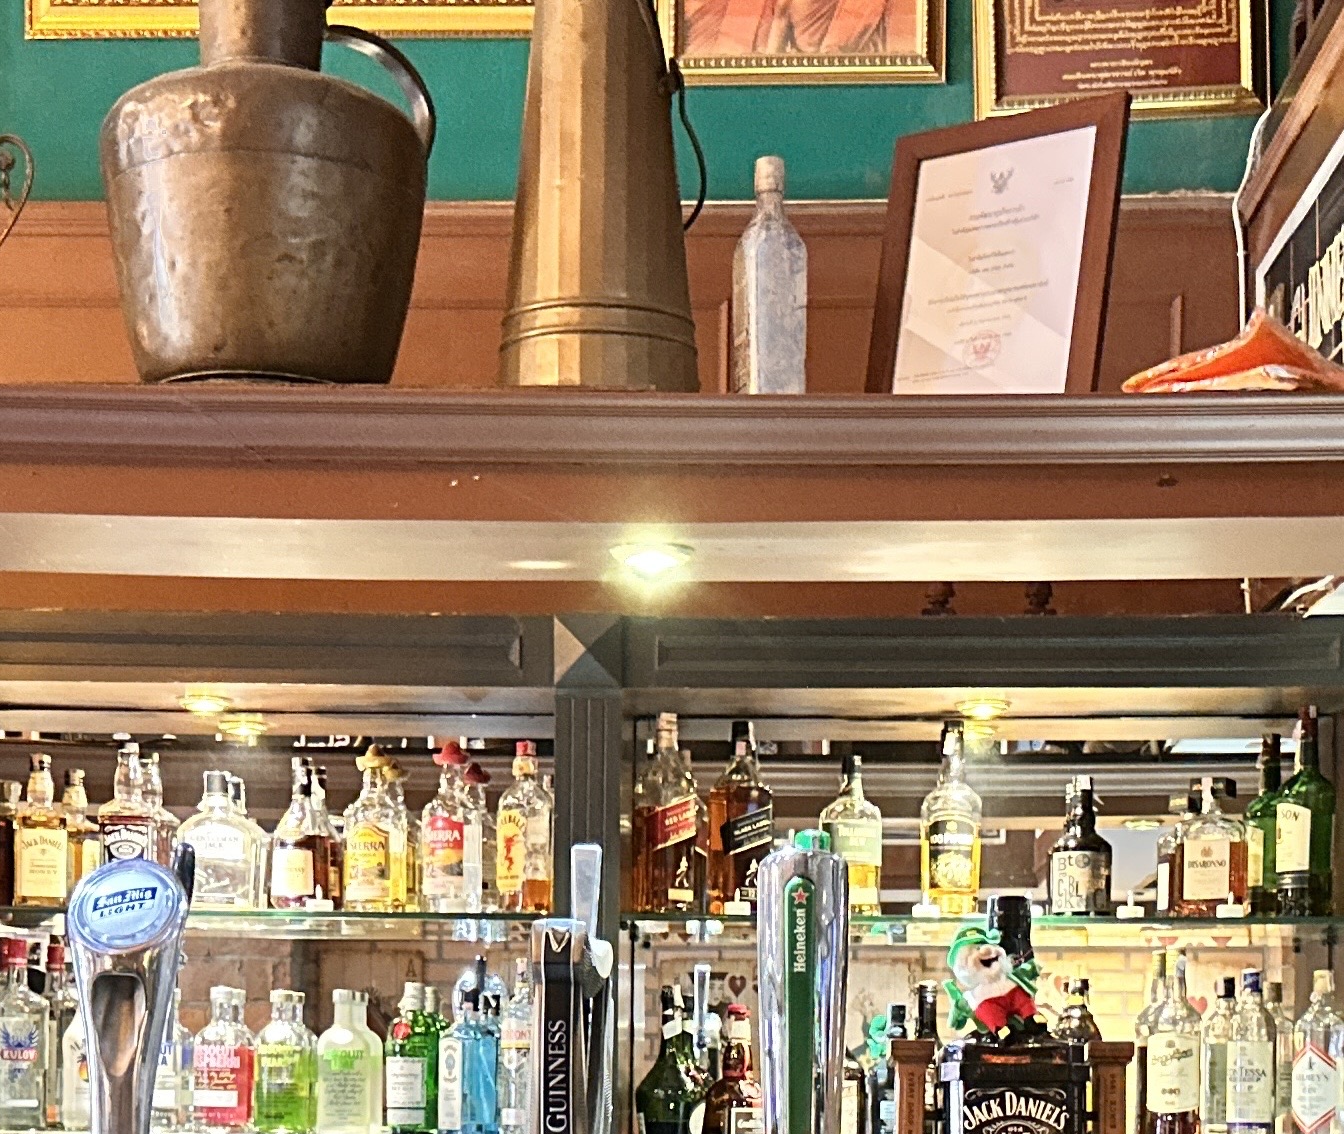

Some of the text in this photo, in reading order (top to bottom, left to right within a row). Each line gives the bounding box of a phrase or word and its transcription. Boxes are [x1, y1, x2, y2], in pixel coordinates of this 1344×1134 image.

[793, 906, 805, 974] Heineken
[1, 1049, 36, 1061] KULOV
[546, 1019, 568, 1134] GUINNESS
[963, 1091, 1070, 1131] JACK DANIEL'S
